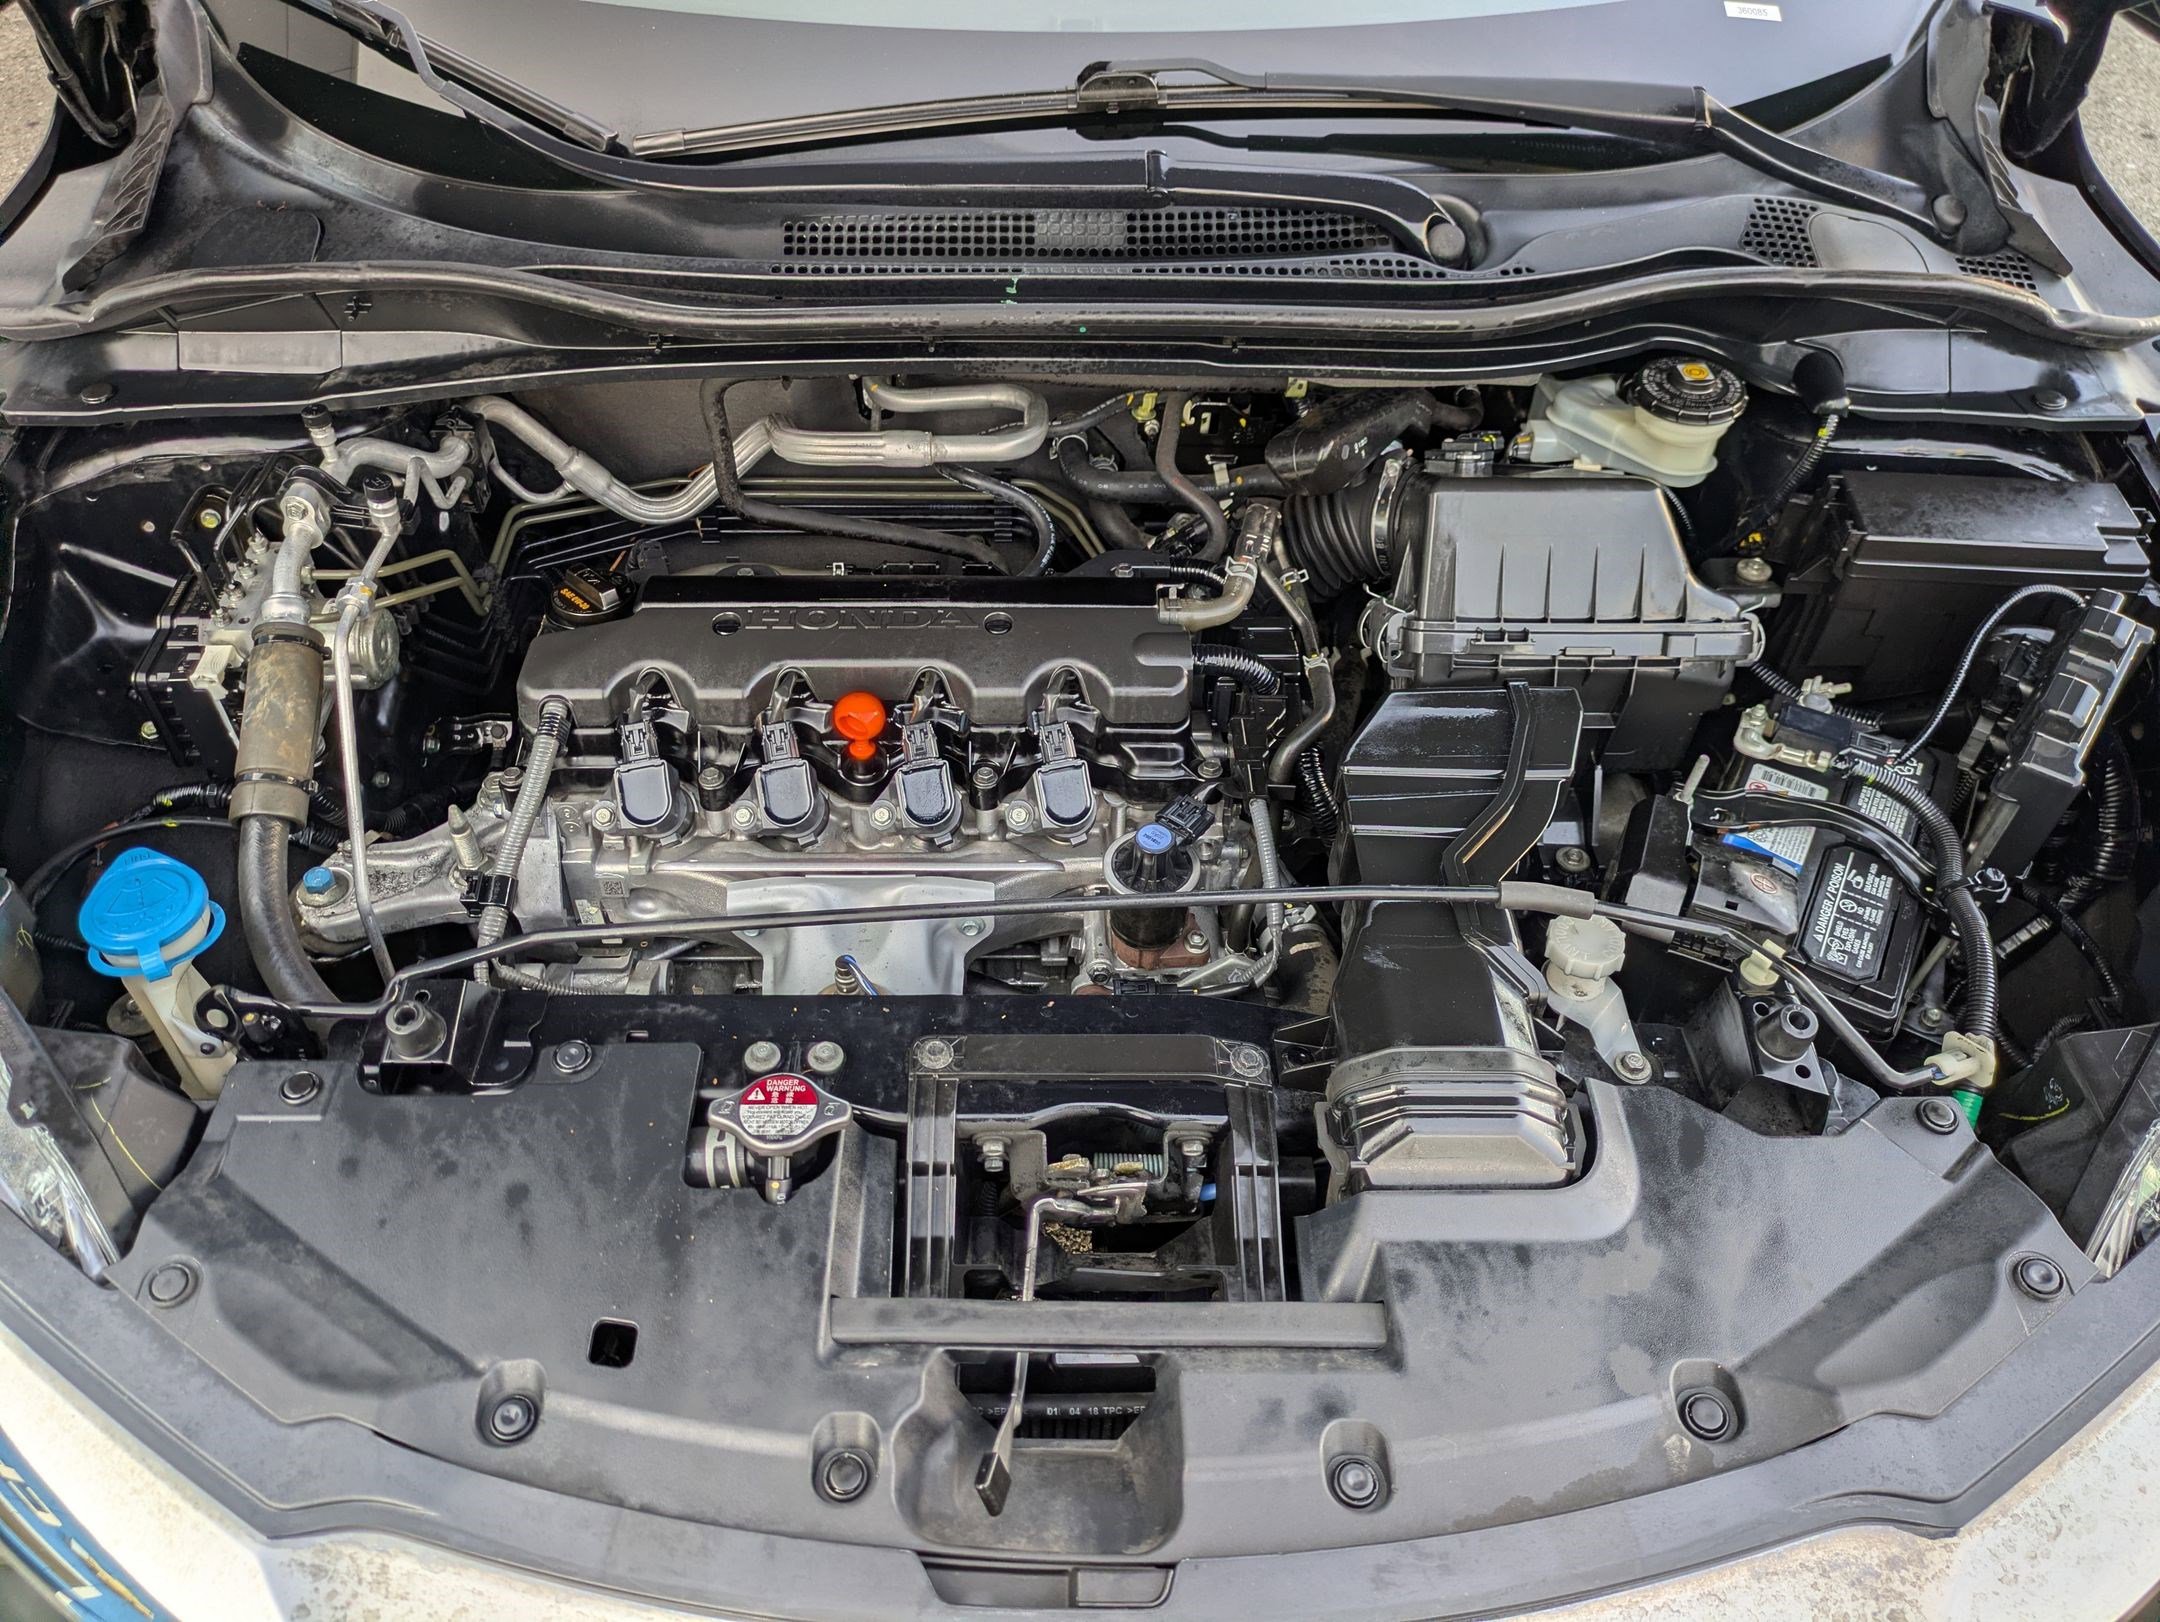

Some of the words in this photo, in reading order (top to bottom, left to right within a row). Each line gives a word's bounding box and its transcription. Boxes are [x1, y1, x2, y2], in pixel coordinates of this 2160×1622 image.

[560, 588, 575, 598] SAE
[744, 609, 979, 630] HONDA
[1815, 900, 1833, 934] DANGER
[1827, 863, 1845, 894] POISON
[1069, 1407, 1080, 1415] 04
[1088, 1407, 1099, 1415] 18
[1102, 1406, 1122, 1415] TPC
